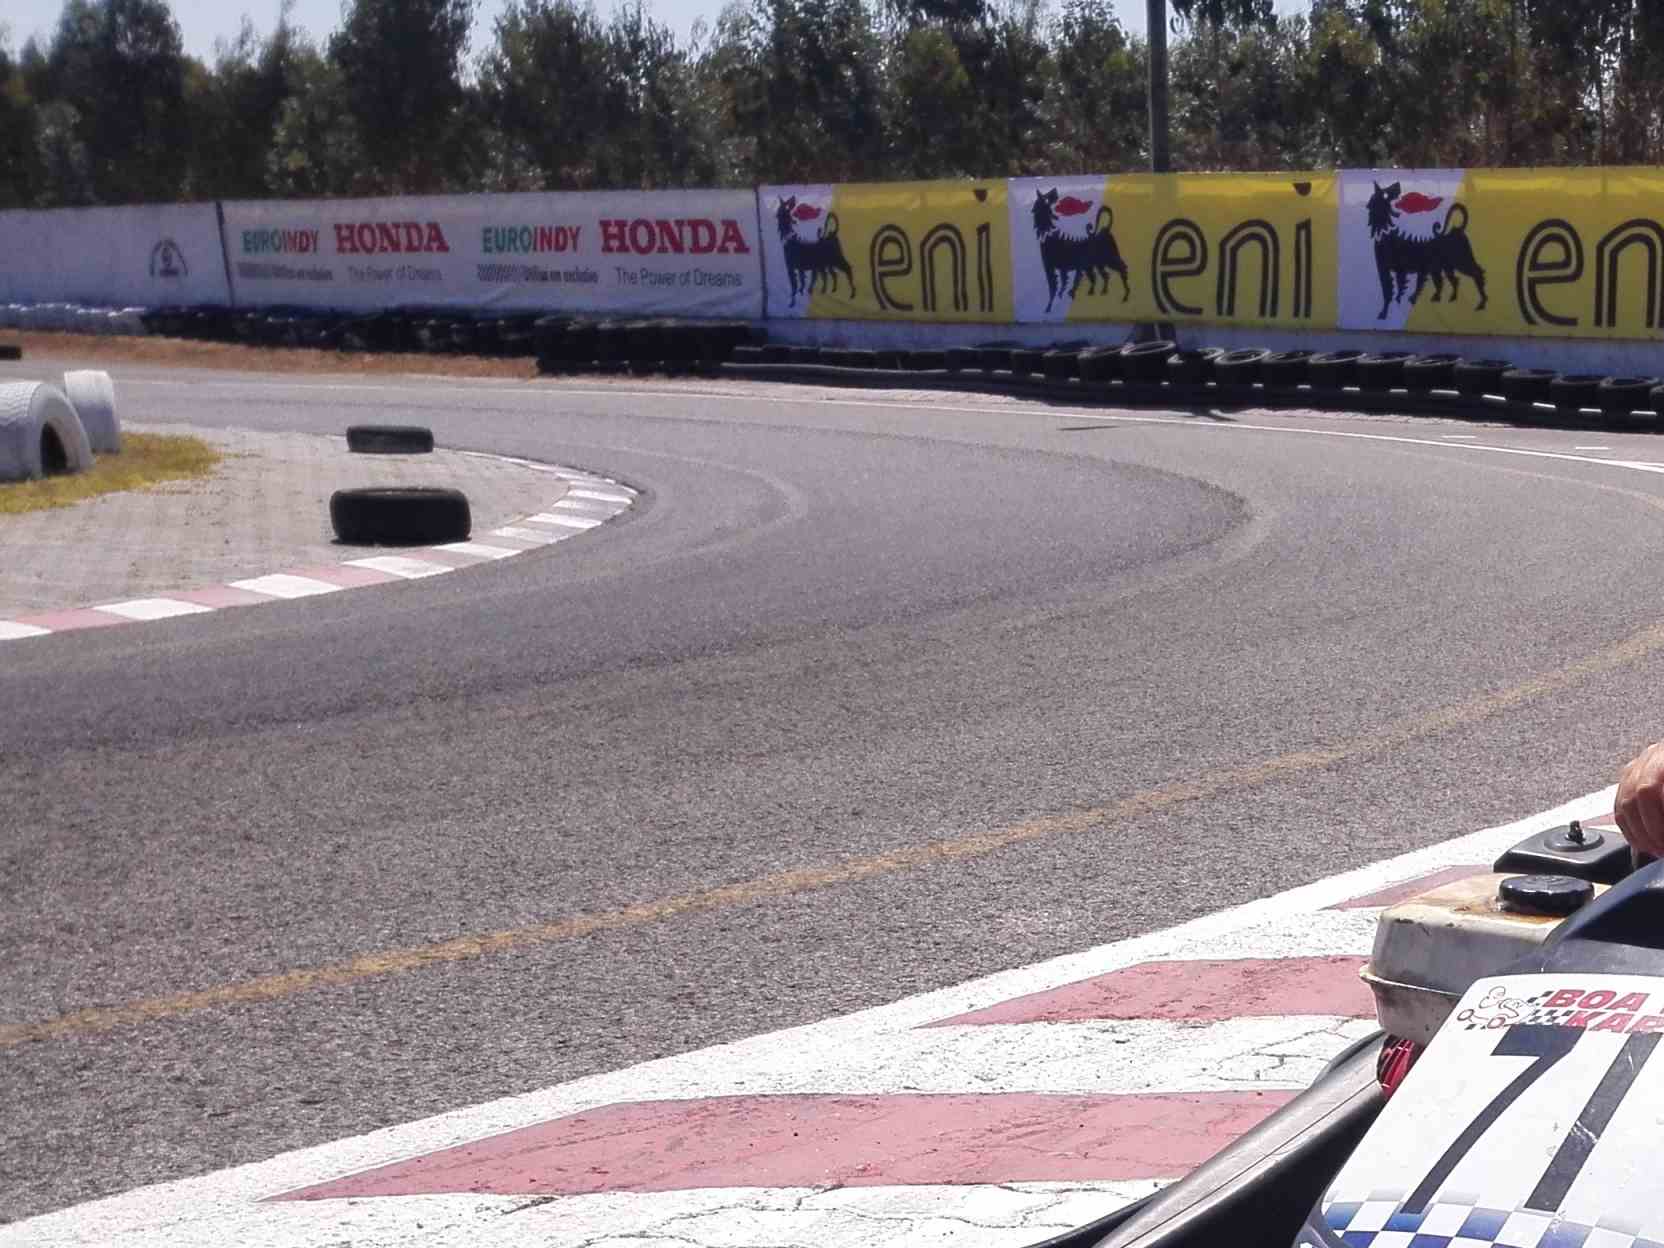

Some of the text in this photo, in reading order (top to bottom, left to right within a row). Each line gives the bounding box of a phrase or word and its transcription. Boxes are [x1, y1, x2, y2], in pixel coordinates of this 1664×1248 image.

[241, 229, 320, 254] EUROINDY
[334, 222, 450, 254] HONDA
[482, 225, 582, 253] EUROINDY
[599, 218, 750, 255] HONDA
[870, 188, 993, 313] eni
[1151, 181, 1313, 319] eni
[616, 267, 640, 286] The
[641, 268, 676, 287] Power
[678, 269, 691, 287] of
[694, 269, 742, 288] Dreams
[1543, 989, 1651, 1012] BOA
[1399, 1023, 1664, 1214] 71
